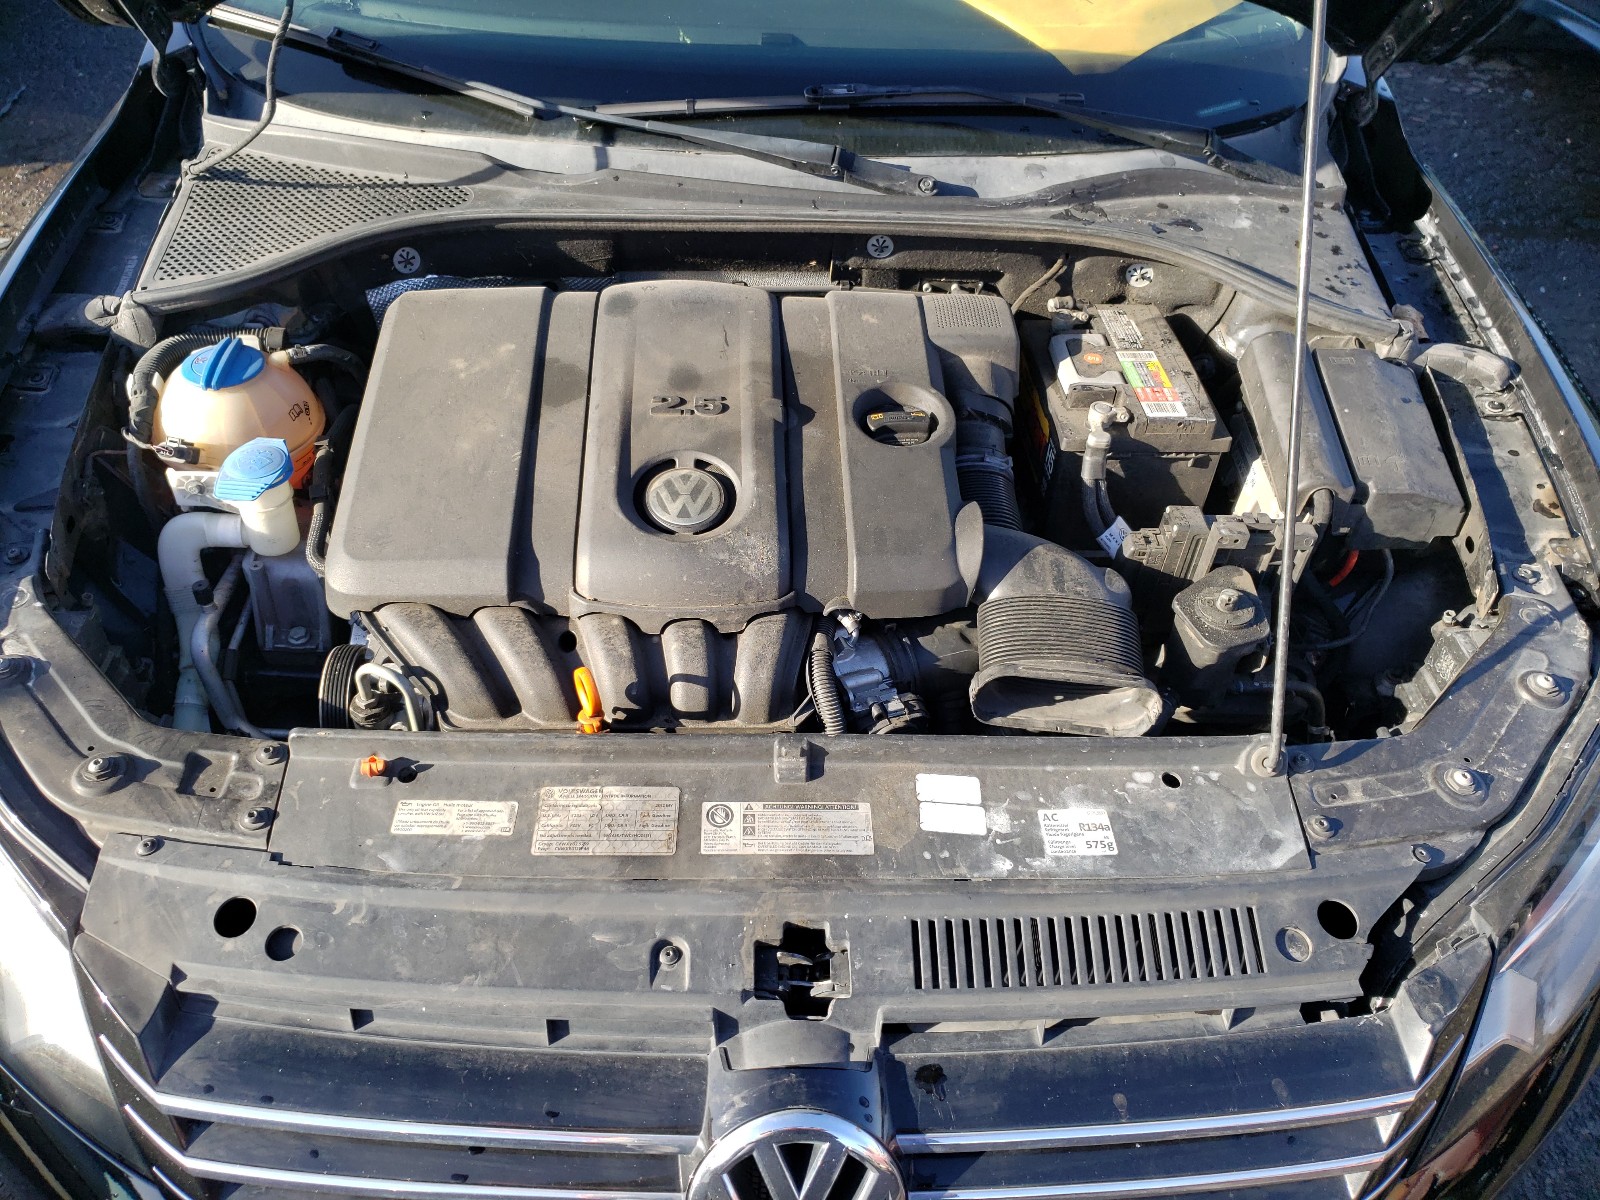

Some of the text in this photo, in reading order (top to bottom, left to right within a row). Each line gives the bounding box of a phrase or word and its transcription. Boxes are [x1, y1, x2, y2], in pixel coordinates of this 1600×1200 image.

[650, 395, 728, 417] 2.5
[650, 469, 722, 522] VW
[1043, 813, 1059, 822] AC
[1078, 822, 1111, 832] R134a
[1085, 840, 1115, 852] 575g
